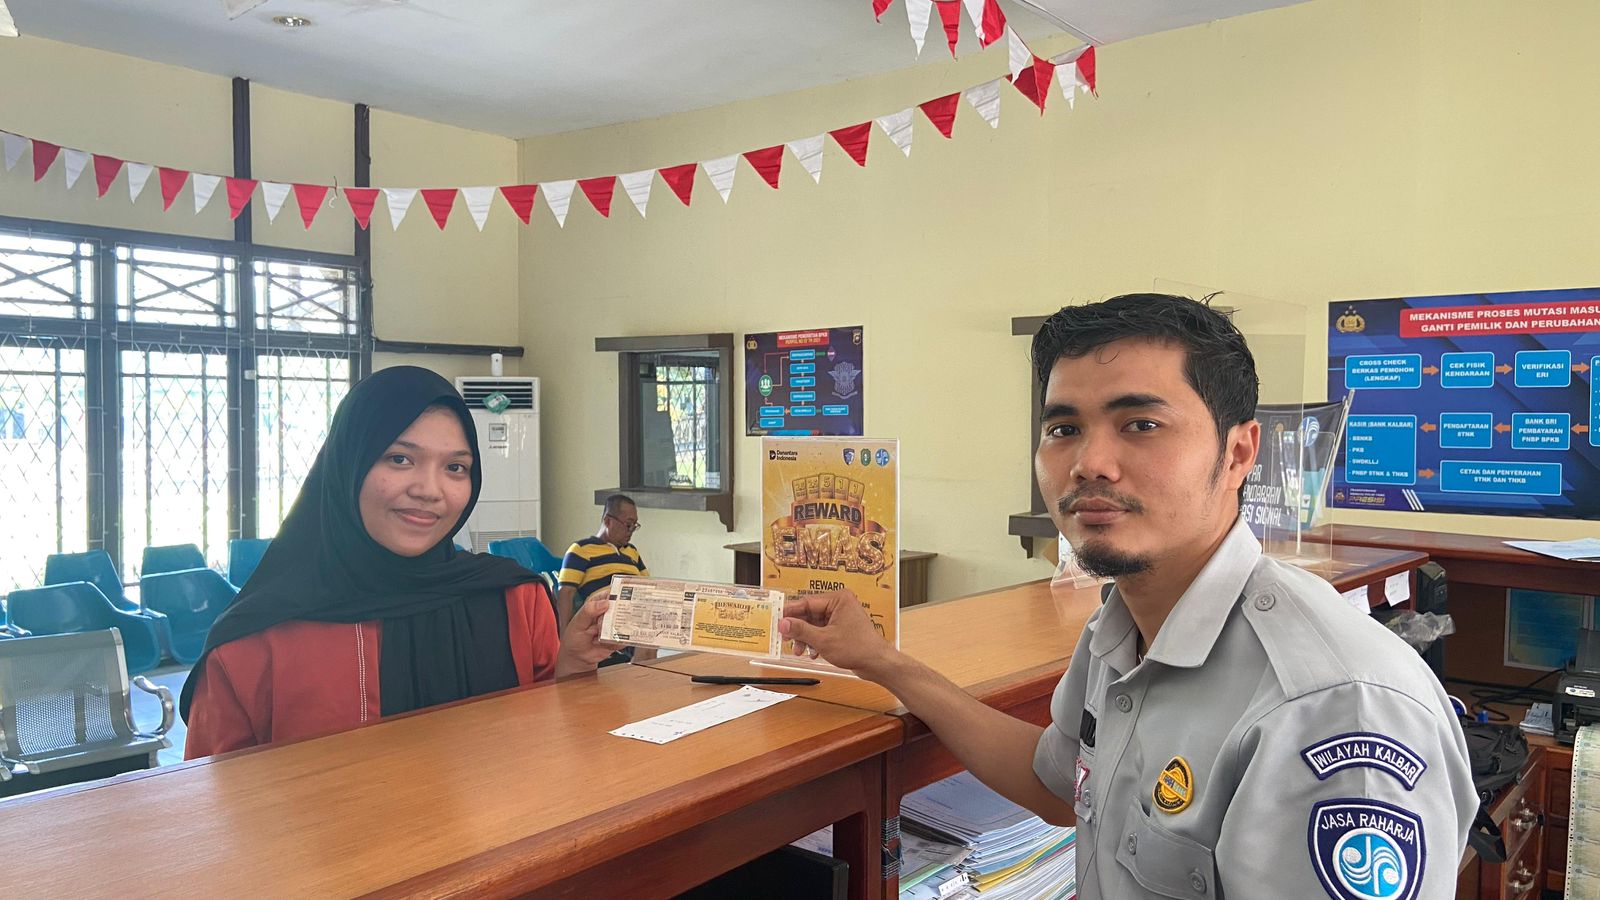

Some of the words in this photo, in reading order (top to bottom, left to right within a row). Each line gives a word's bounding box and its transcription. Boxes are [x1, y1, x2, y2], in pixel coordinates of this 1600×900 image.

[1410, 311, 1474, 321] MEKANISME
[1477, 310, 1520, 318] PROSES
[1524, 308, 1567, 316] MUTASI
[1420, 324, 1454, 332] GANTI
[1457, 322, 1502, 331] PEMILIK
[1505, 320, 1528, 329] DAN
[1531, 318, 1600, 328] PERUBAHAN
[1522, 362, 1564, 370] VERIFIKASI
[794, 502, 862, 524] REWARD
[772, 524, 886, 576] EMAS
[809, 580, 845, 591] REWARD
[1314, 743, 1370, 767] WILAYAH
[1375, 745, 1416, 779] KALBAR
[1321, 812, 1356, 830] JASA
[1360, 814, 1415, 845] RAHARJA
